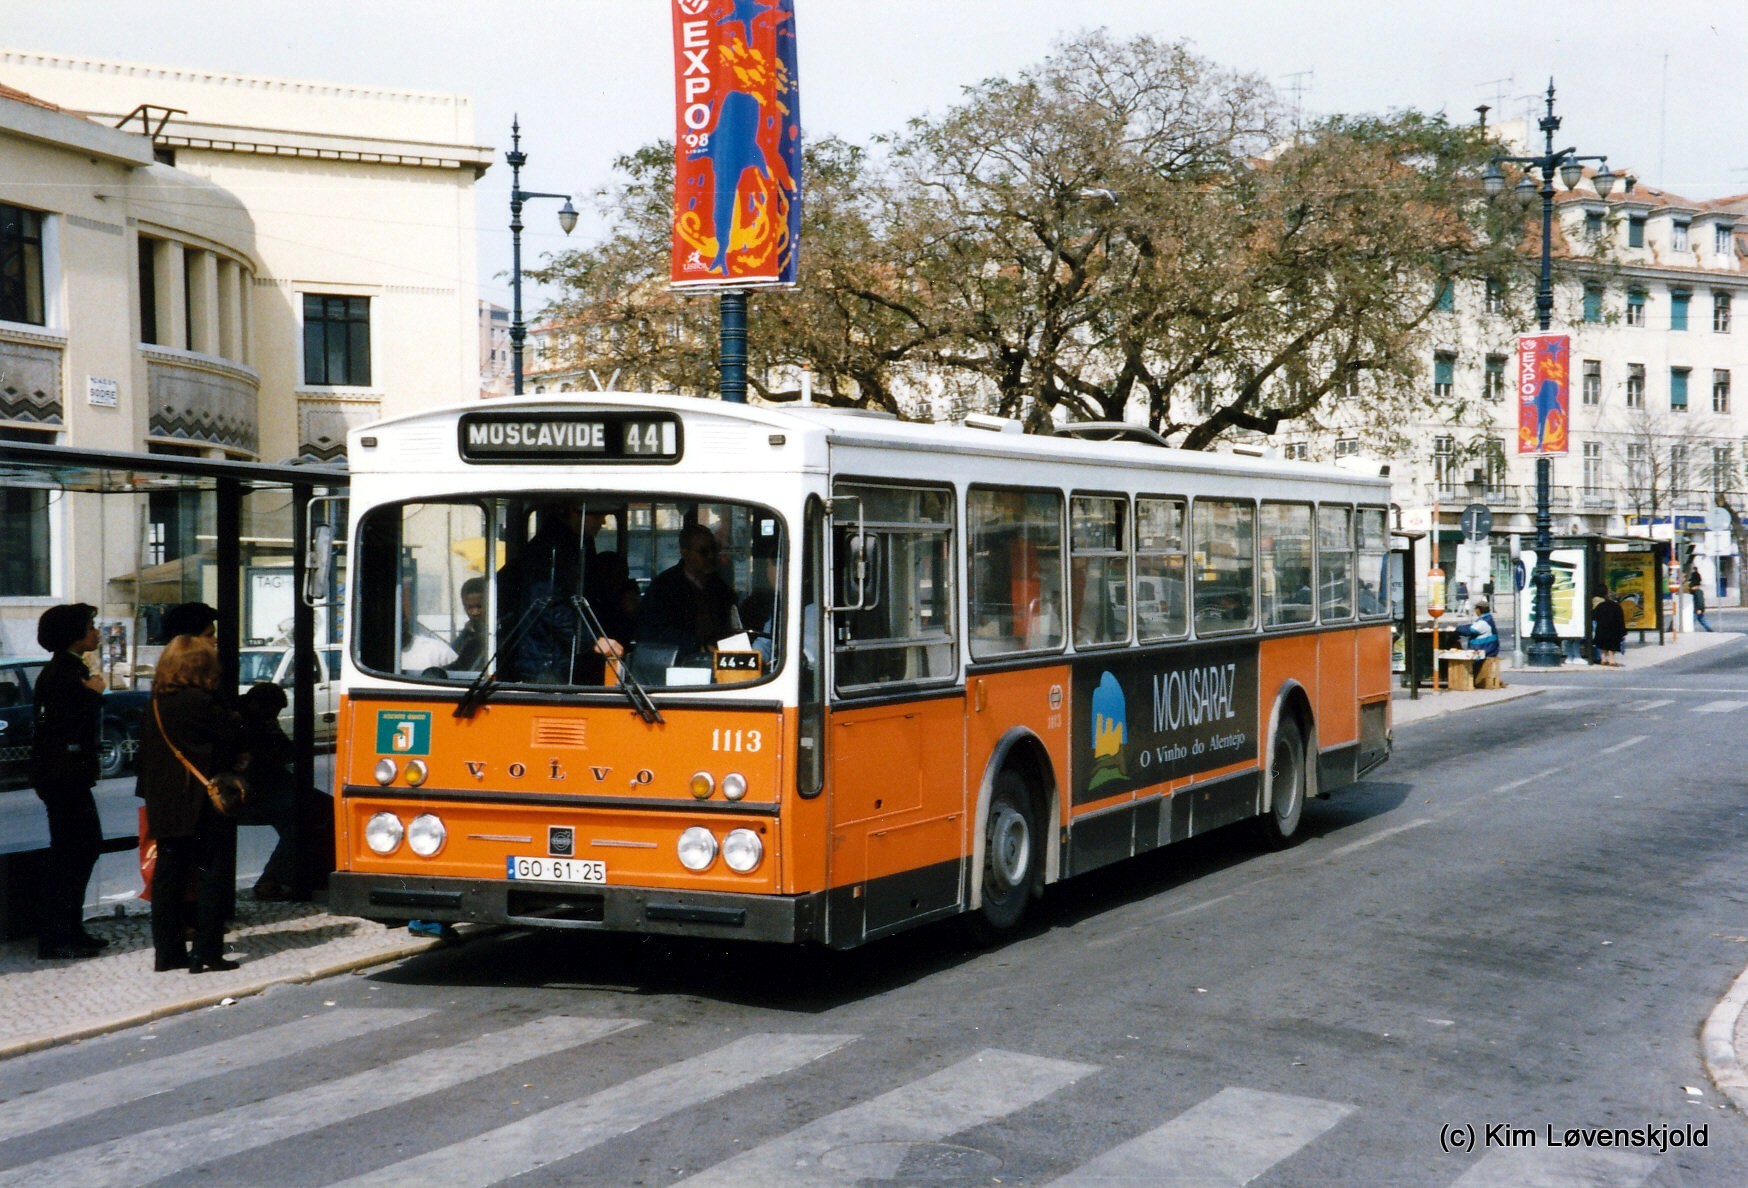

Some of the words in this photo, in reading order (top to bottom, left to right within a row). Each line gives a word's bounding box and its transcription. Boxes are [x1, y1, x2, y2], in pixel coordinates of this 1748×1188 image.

[682, 19, 711, 131] EXPO
[1521, 351, 1536, 395] EXPO
[469, 422, 605, 447] MOSCAVIDE
[627, 423, 659, 453] 44
[1153, 663, 1236, 733] MONSARAZ
[712, 729, 762, 752] 1113
[1139, 750, 1151, 768] O
[1157, 745, 1187, 764] Vinho
[1191, 740, 1205, 755] do
[1209, 729, 1246, 751] Alentejo
[465, 760, 655, 786] VOLVO
